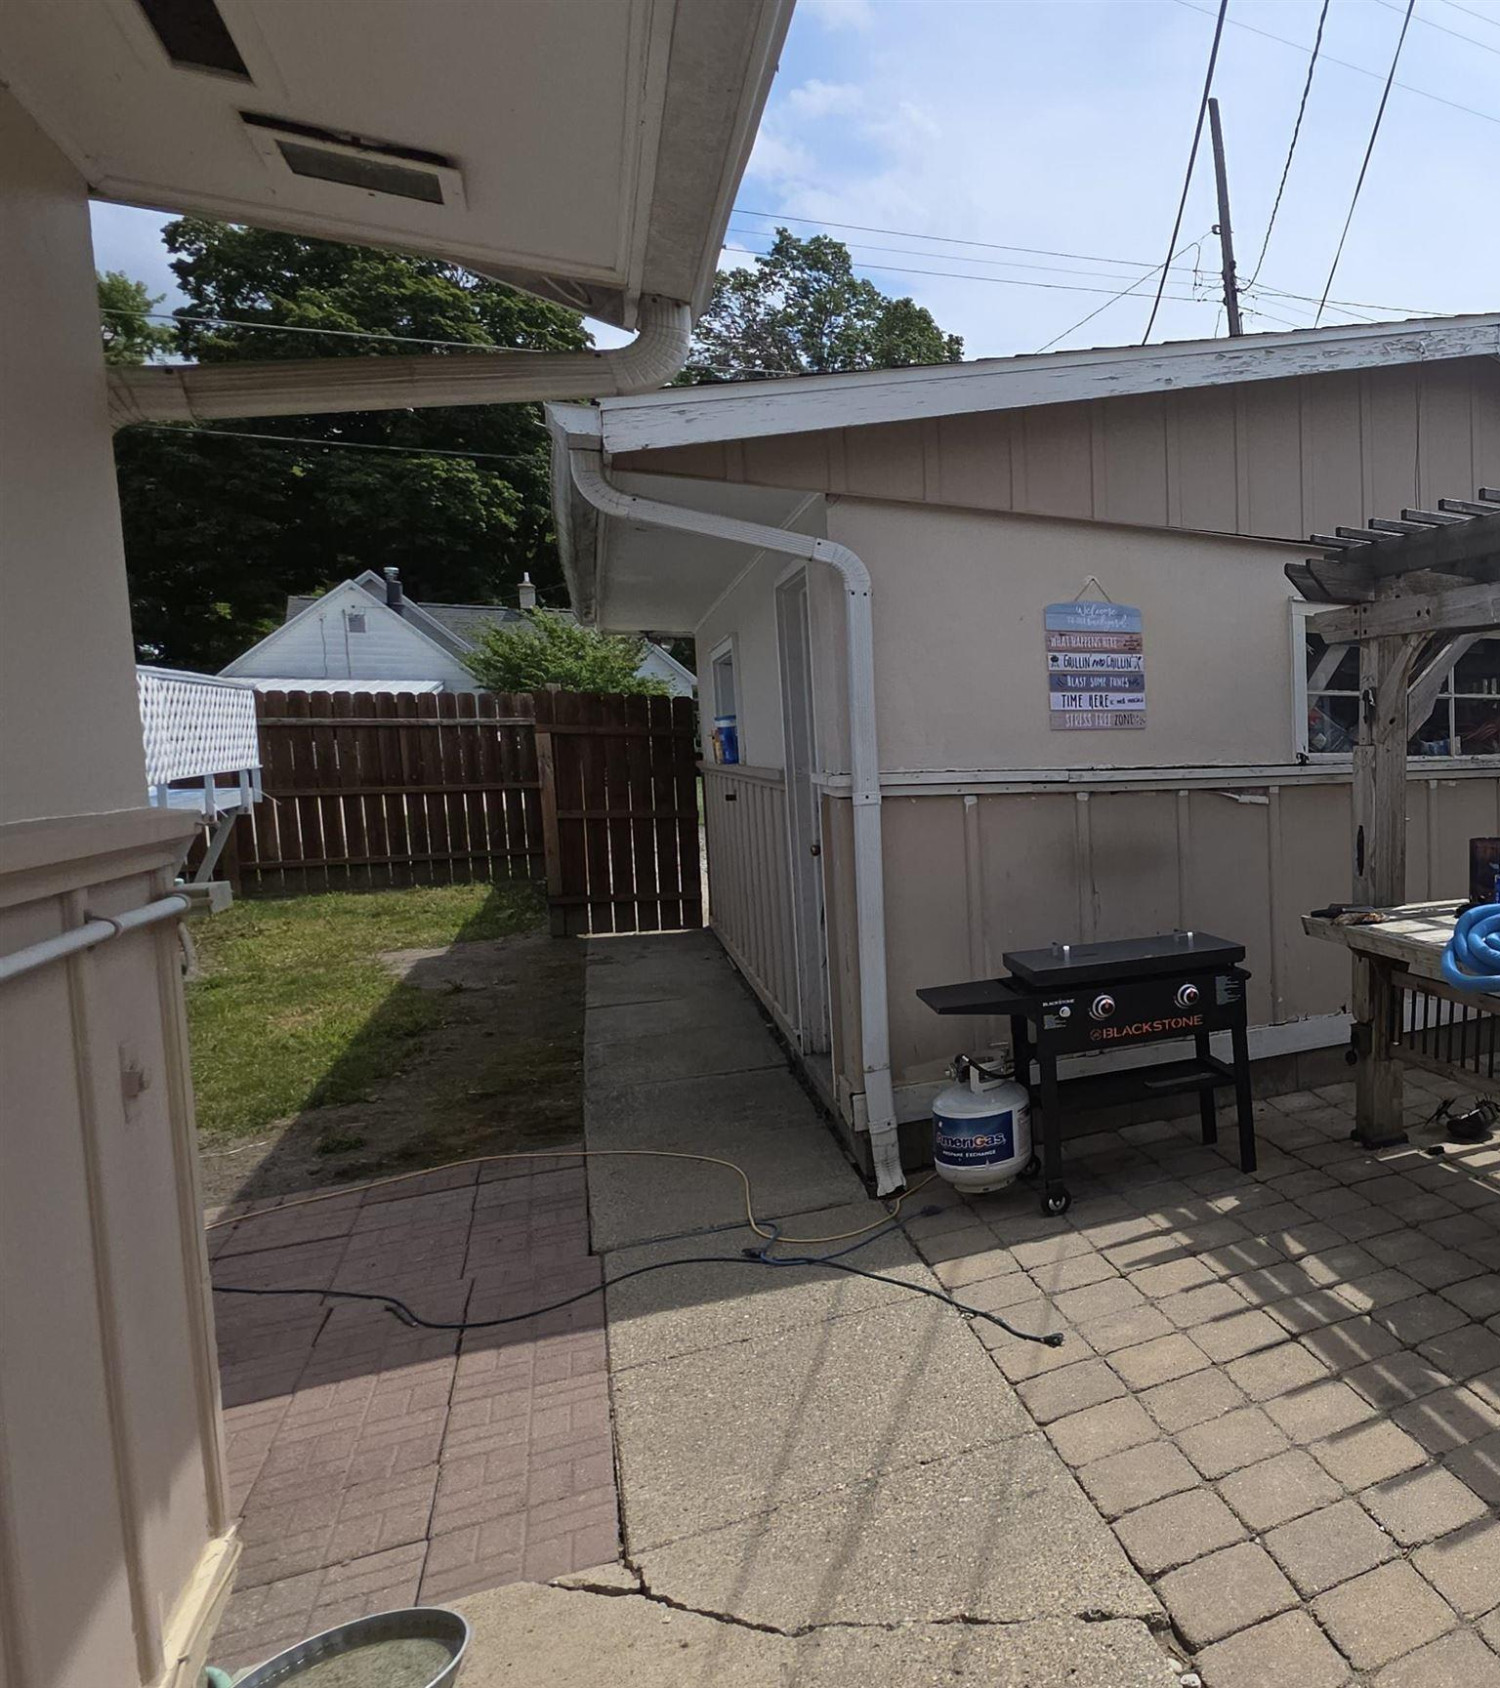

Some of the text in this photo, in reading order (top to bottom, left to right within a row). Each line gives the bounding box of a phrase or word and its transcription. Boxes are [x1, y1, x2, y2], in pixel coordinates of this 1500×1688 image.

[1067, 675, 1129, 688] BLAST SOME TUNES
[1061, 694, 1083, 708] TIME
[1089, 694, 1109, 709] HERE
[1065, 713, 1092, 727] STRESS
[1114, 713, 1133, 725] ZONE
[1102, 1014, 1203, 1039] BLACKSTONE
[936, 1131, 1006, 1148] AmeriGas
